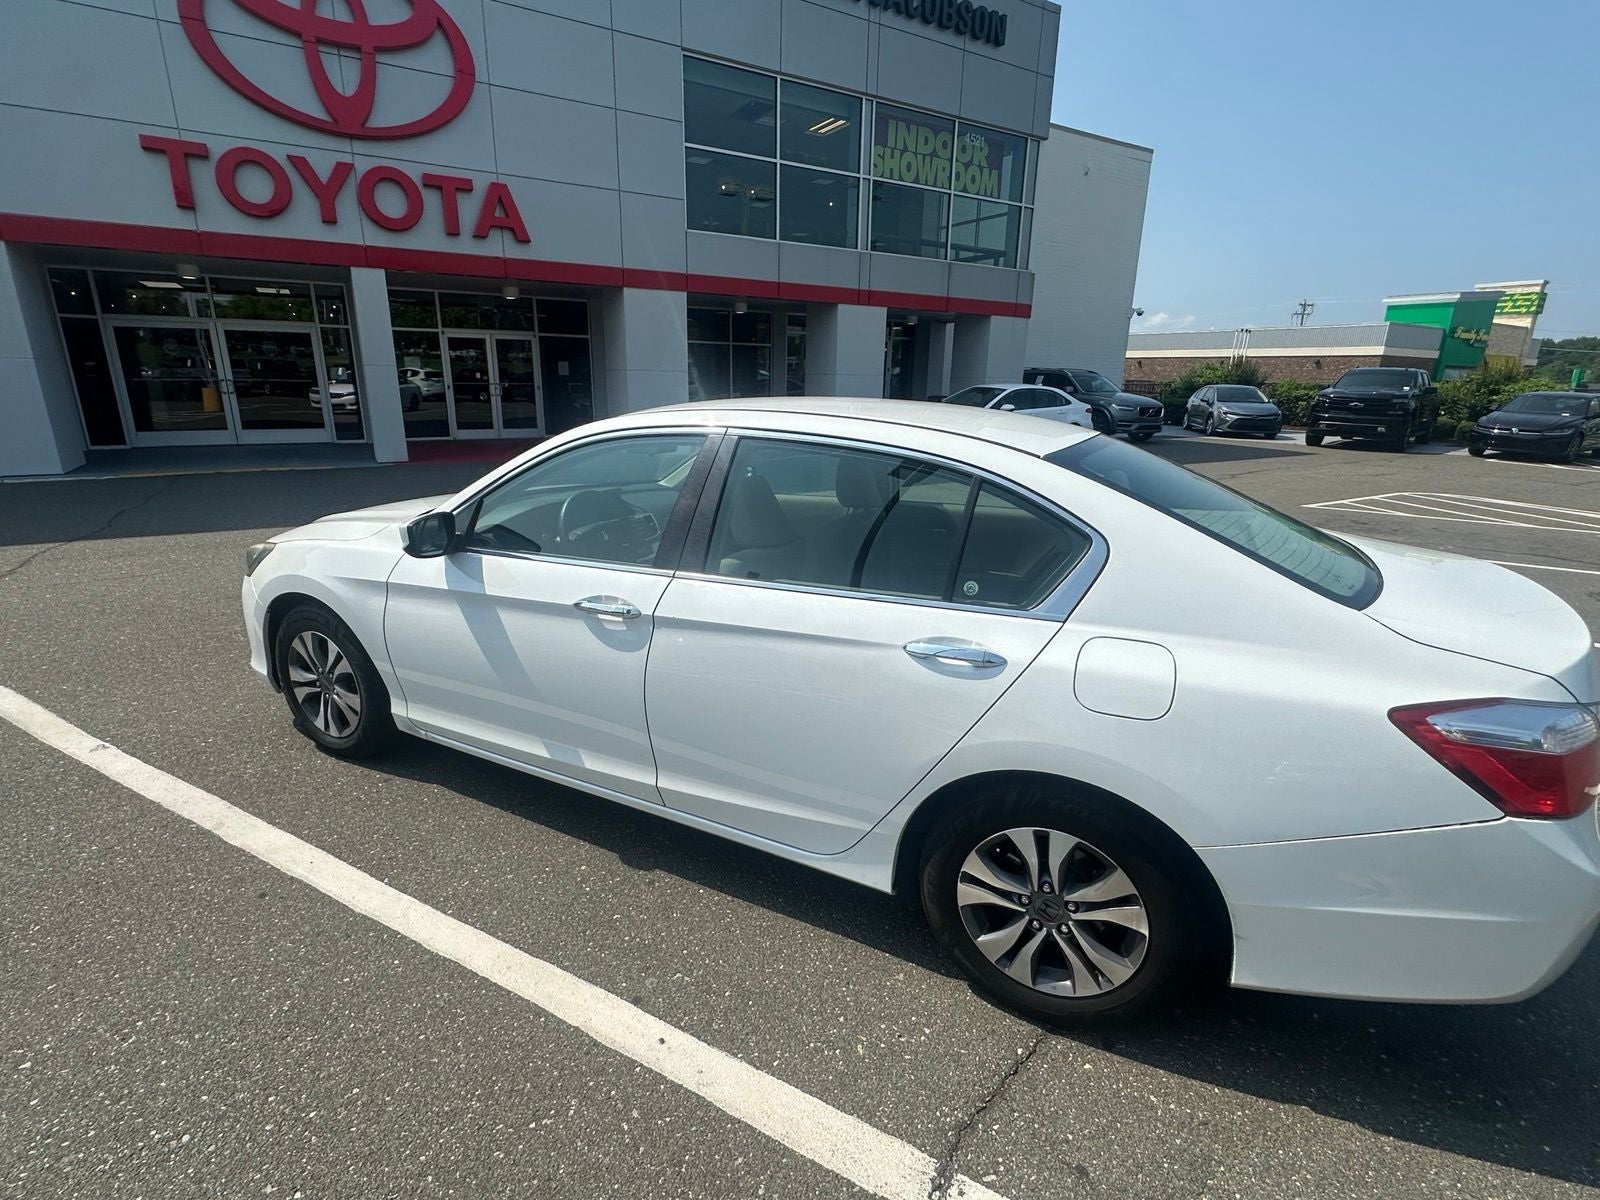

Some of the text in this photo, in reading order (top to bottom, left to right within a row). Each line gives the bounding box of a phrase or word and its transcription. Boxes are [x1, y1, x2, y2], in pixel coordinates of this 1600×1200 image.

[888, 119, 989, 167] INDOOR
[965, 132, 985, 146] 4521
[139, 134, 531, 244] TOYOTA
[873, 145, 998, 197] SHOWROOM
